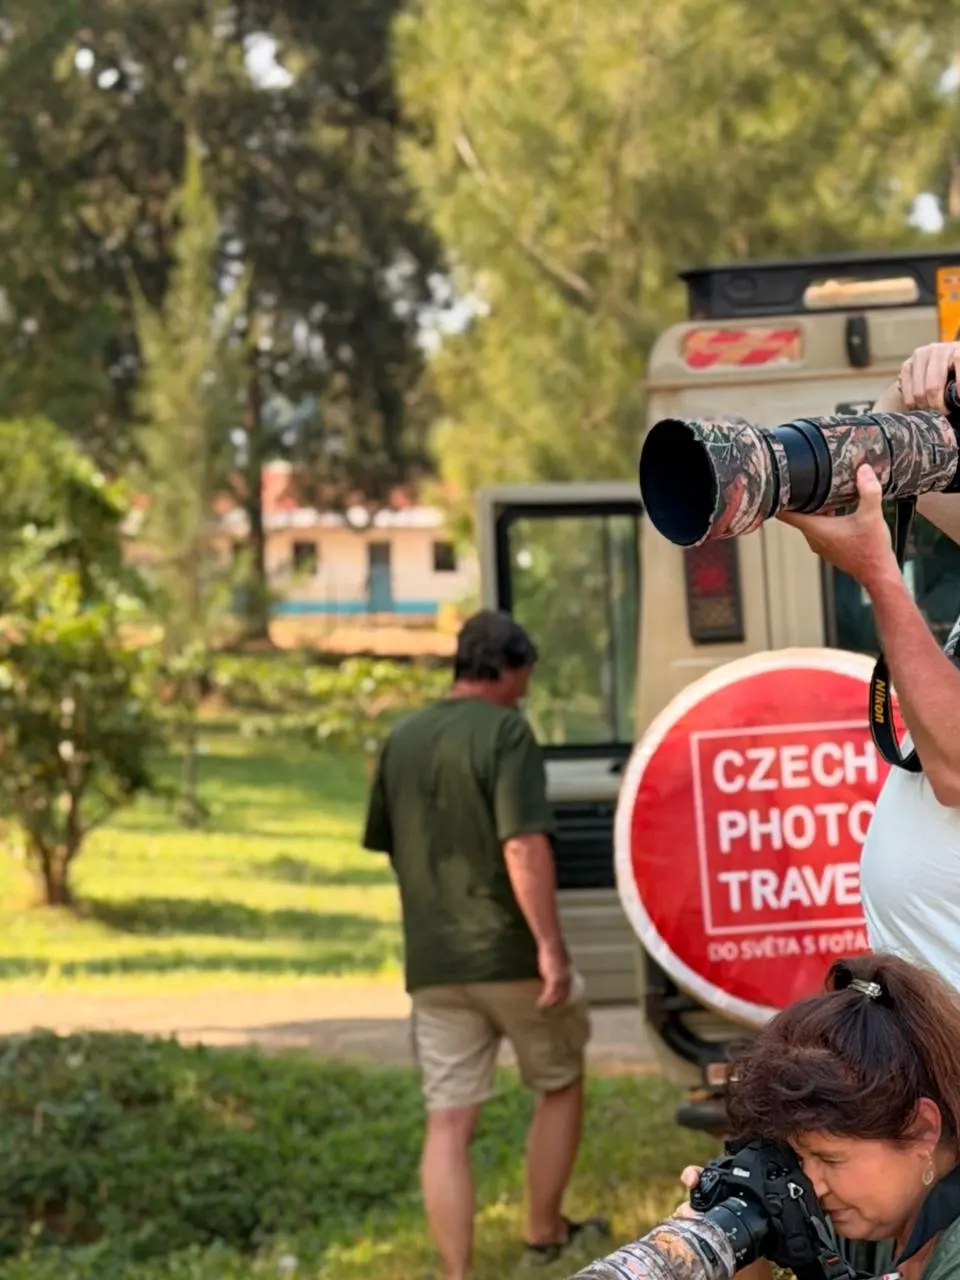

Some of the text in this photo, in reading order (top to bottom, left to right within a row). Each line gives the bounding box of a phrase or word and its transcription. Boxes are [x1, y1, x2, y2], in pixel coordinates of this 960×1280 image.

[874, 679, 887, 724] Nikon
[712, 741, 878, 793] CZECH
[707, 941, 738, 962] DO
[802, 934, 817, 955] S
